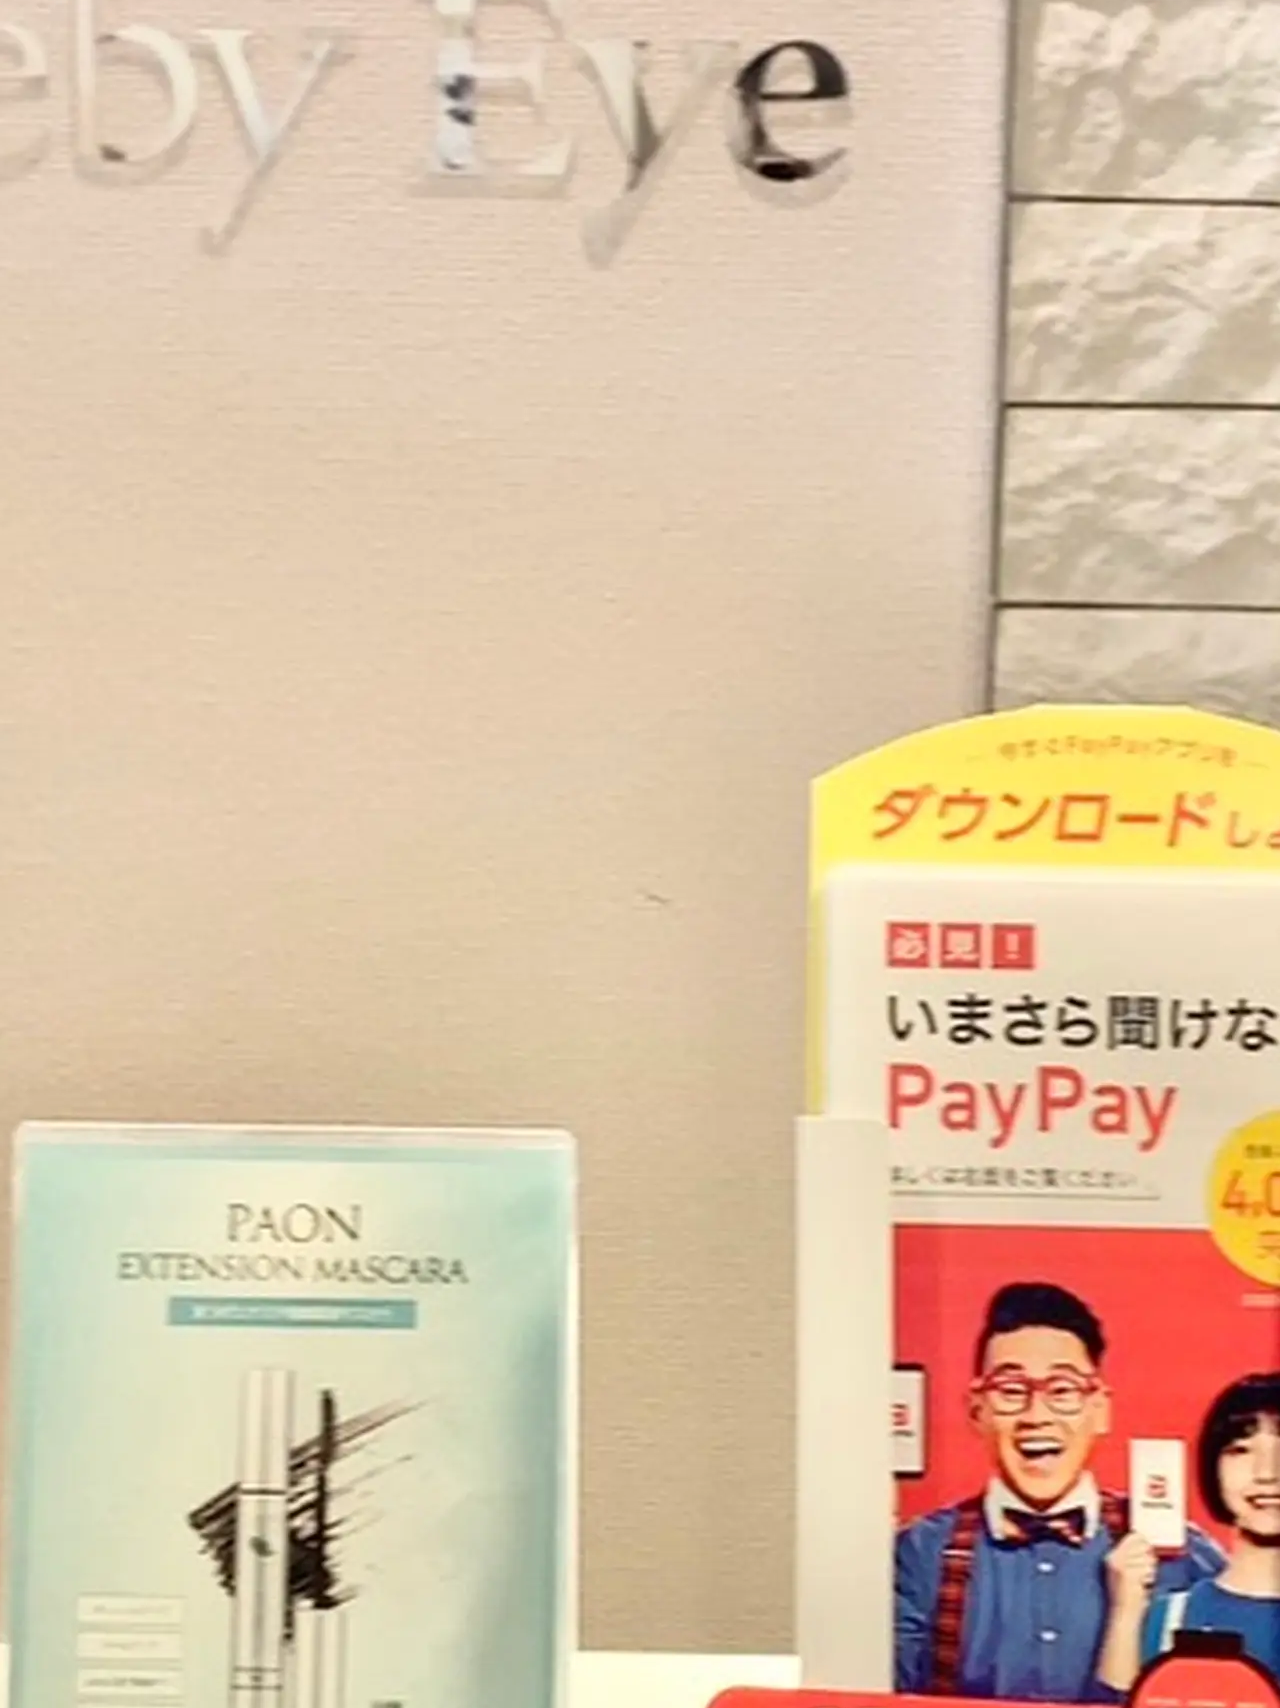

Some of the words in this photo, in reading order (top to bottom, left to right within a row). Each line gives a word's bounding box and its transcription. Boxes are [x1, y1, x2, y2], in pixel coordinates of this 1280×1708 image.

[886, 1062, 1178, 1151] PayPay
[227, 1202, 363, 1244] PAON
[116, 1252, 305, 1282] EXTENSION
[310, 1254, 471, 1285] MASCARA
